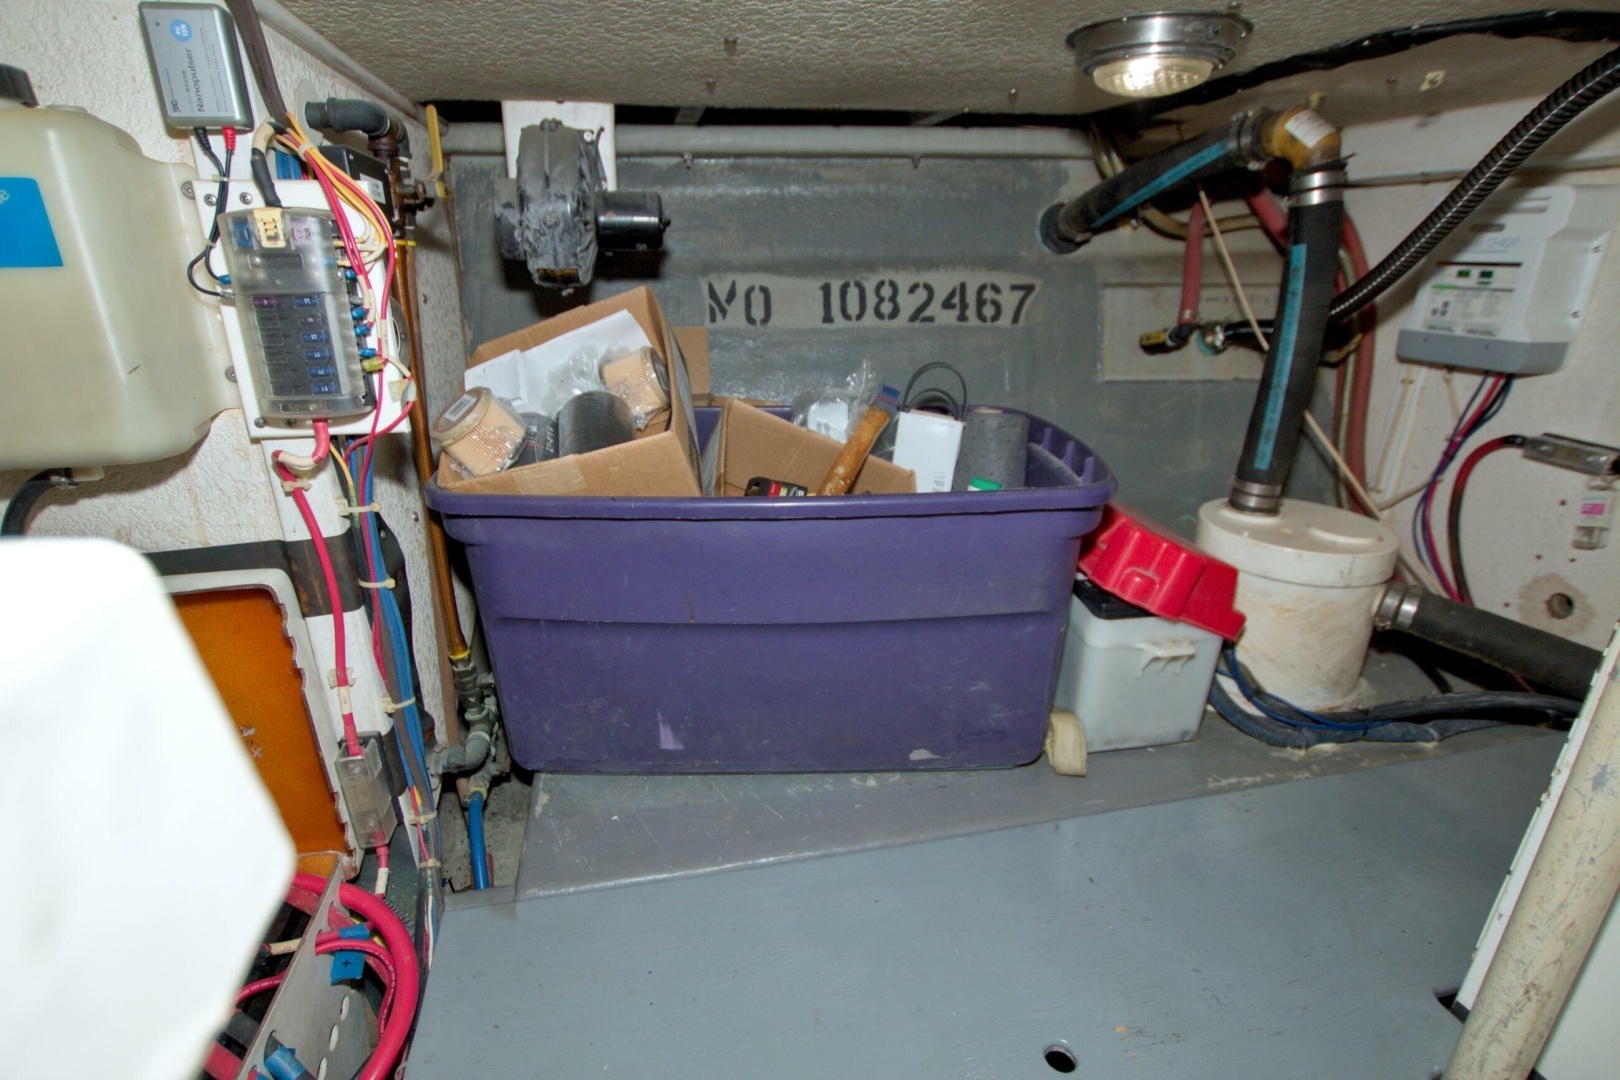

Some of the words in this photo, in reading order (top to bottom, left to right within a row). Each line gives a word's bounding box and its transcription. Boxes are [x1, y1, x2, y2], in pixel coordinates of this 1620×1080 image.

[180, 24, 189, 37] 12N
[185, 48, 205, 112] Nanopulser
[819, 278, 1036, 325] 1082467
